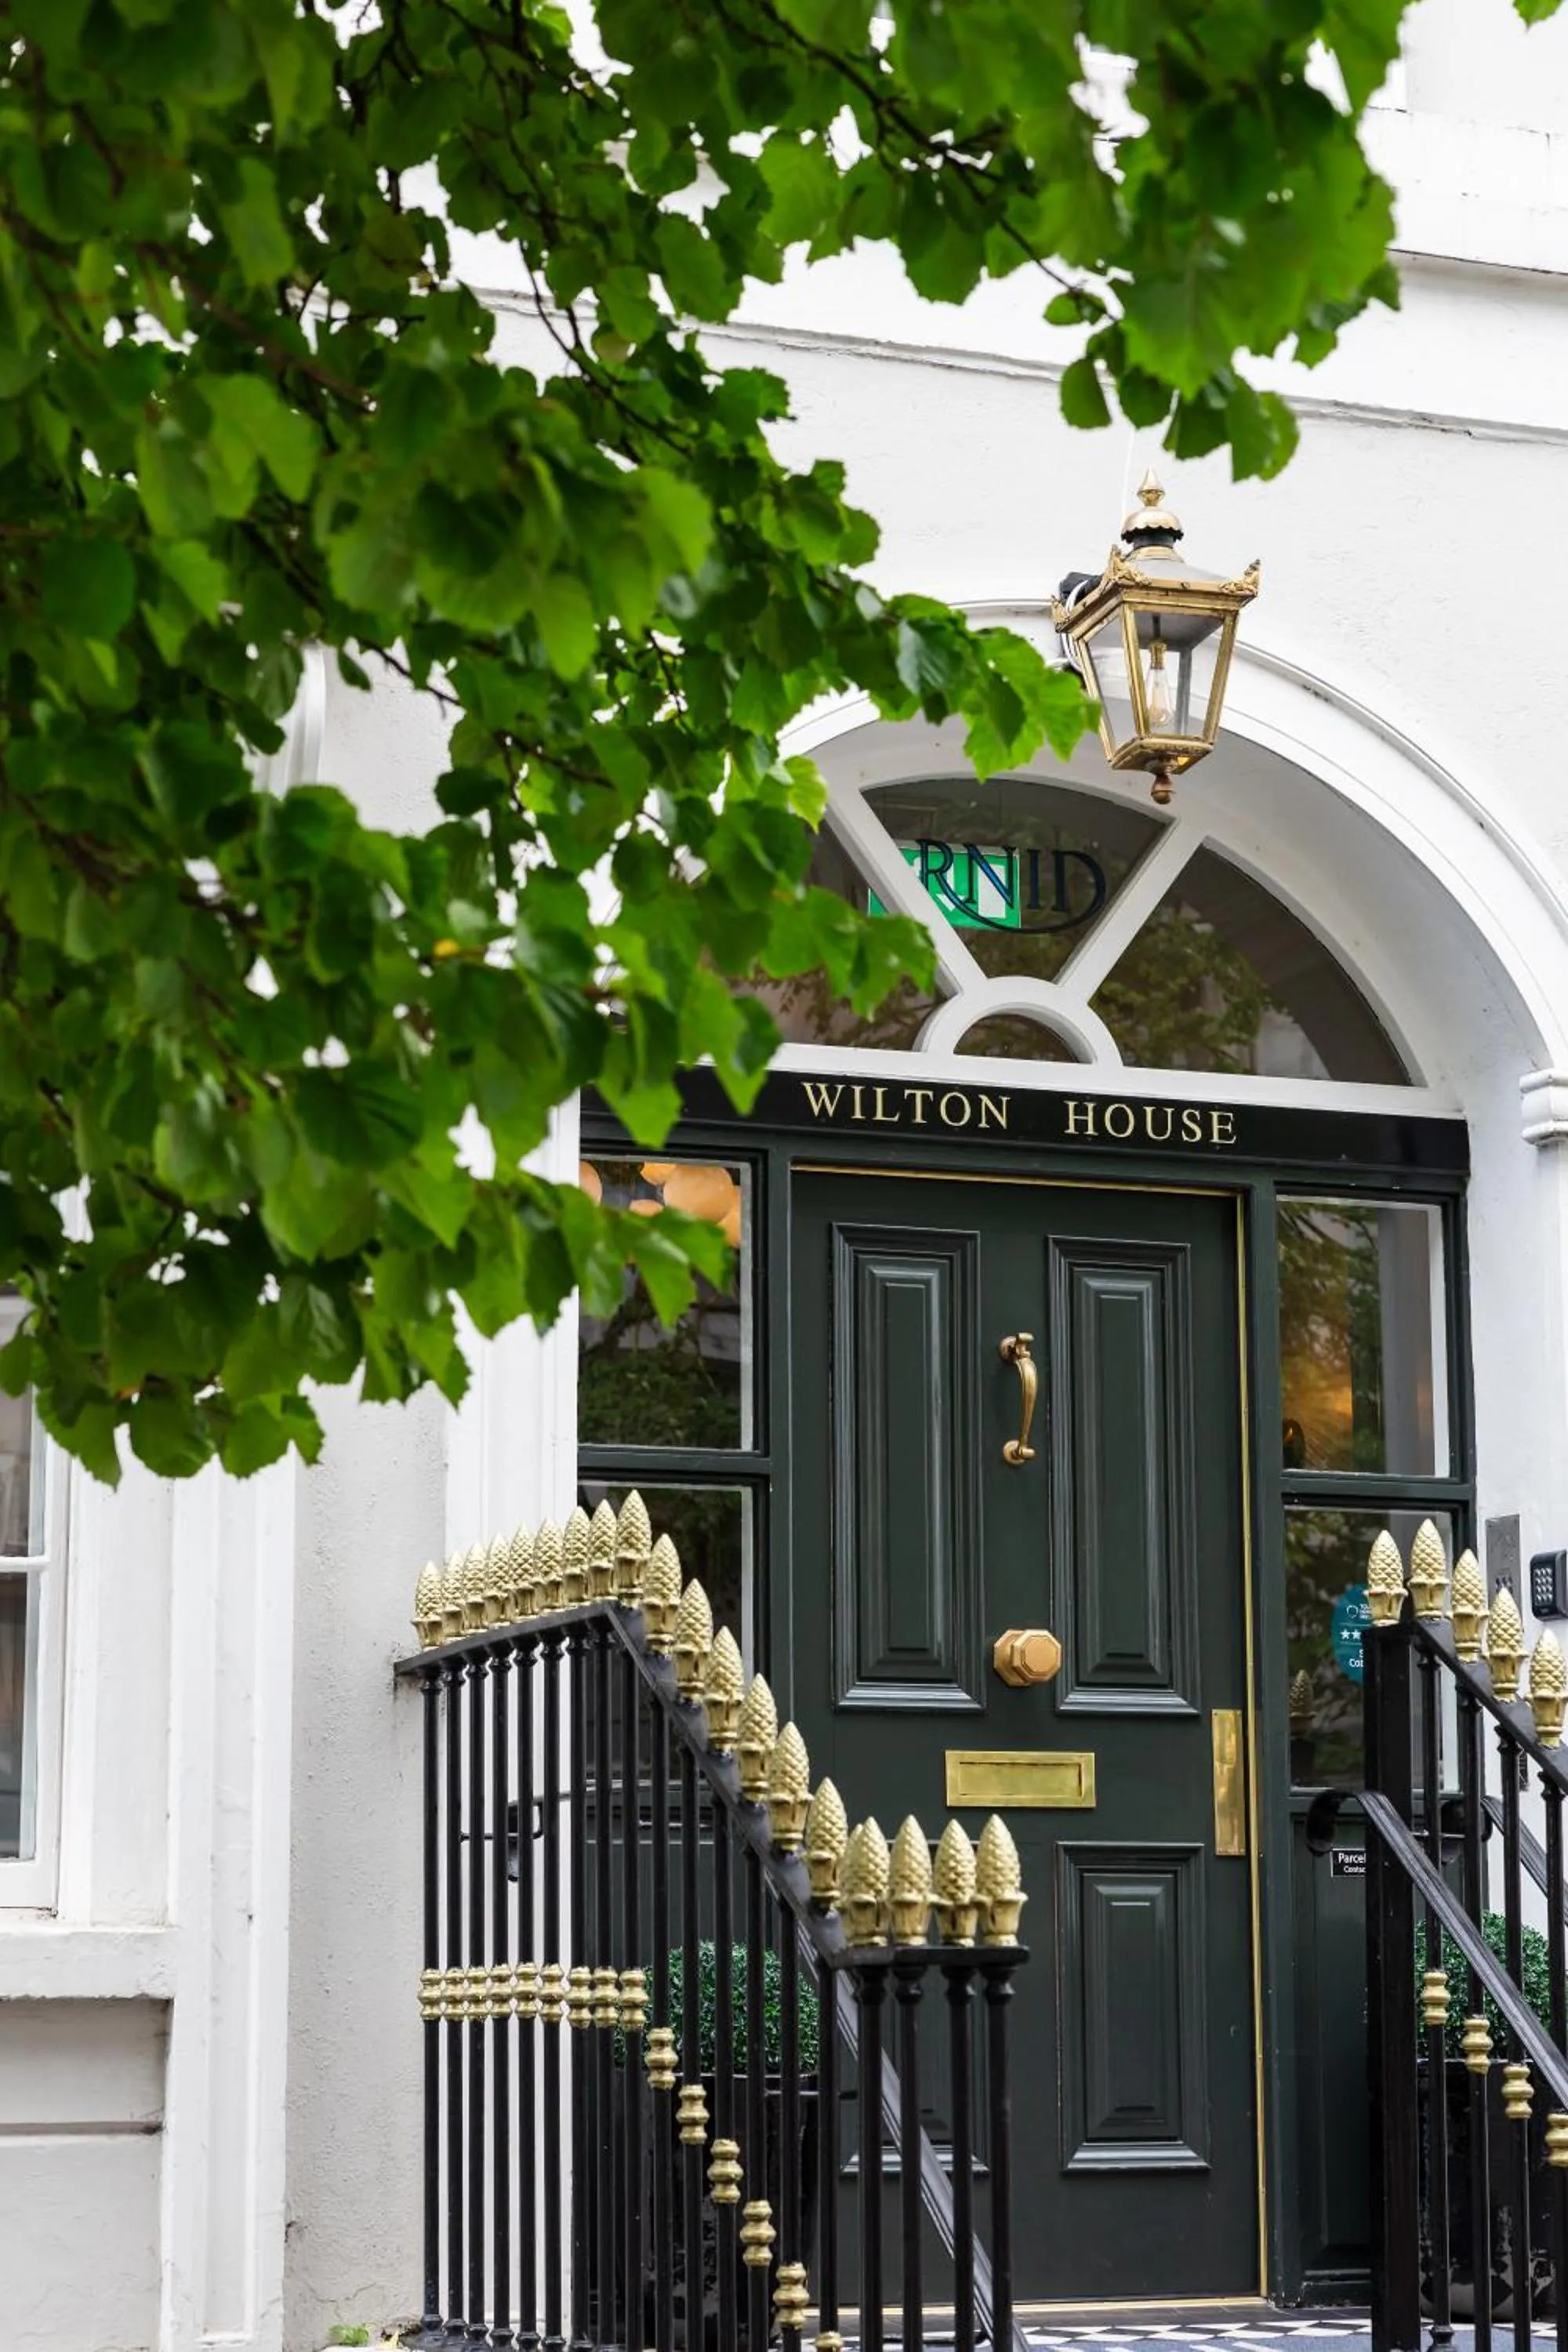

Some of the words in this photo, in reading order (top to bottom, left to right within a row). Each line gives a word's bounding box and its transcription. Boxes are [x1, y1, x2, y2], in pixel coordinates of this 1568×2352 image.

[916, 838, 1106, 934] RNID
[801, 1081, 1011, 1130] WILTON
[1064, 1100, 1237, 1145] HOUSE
